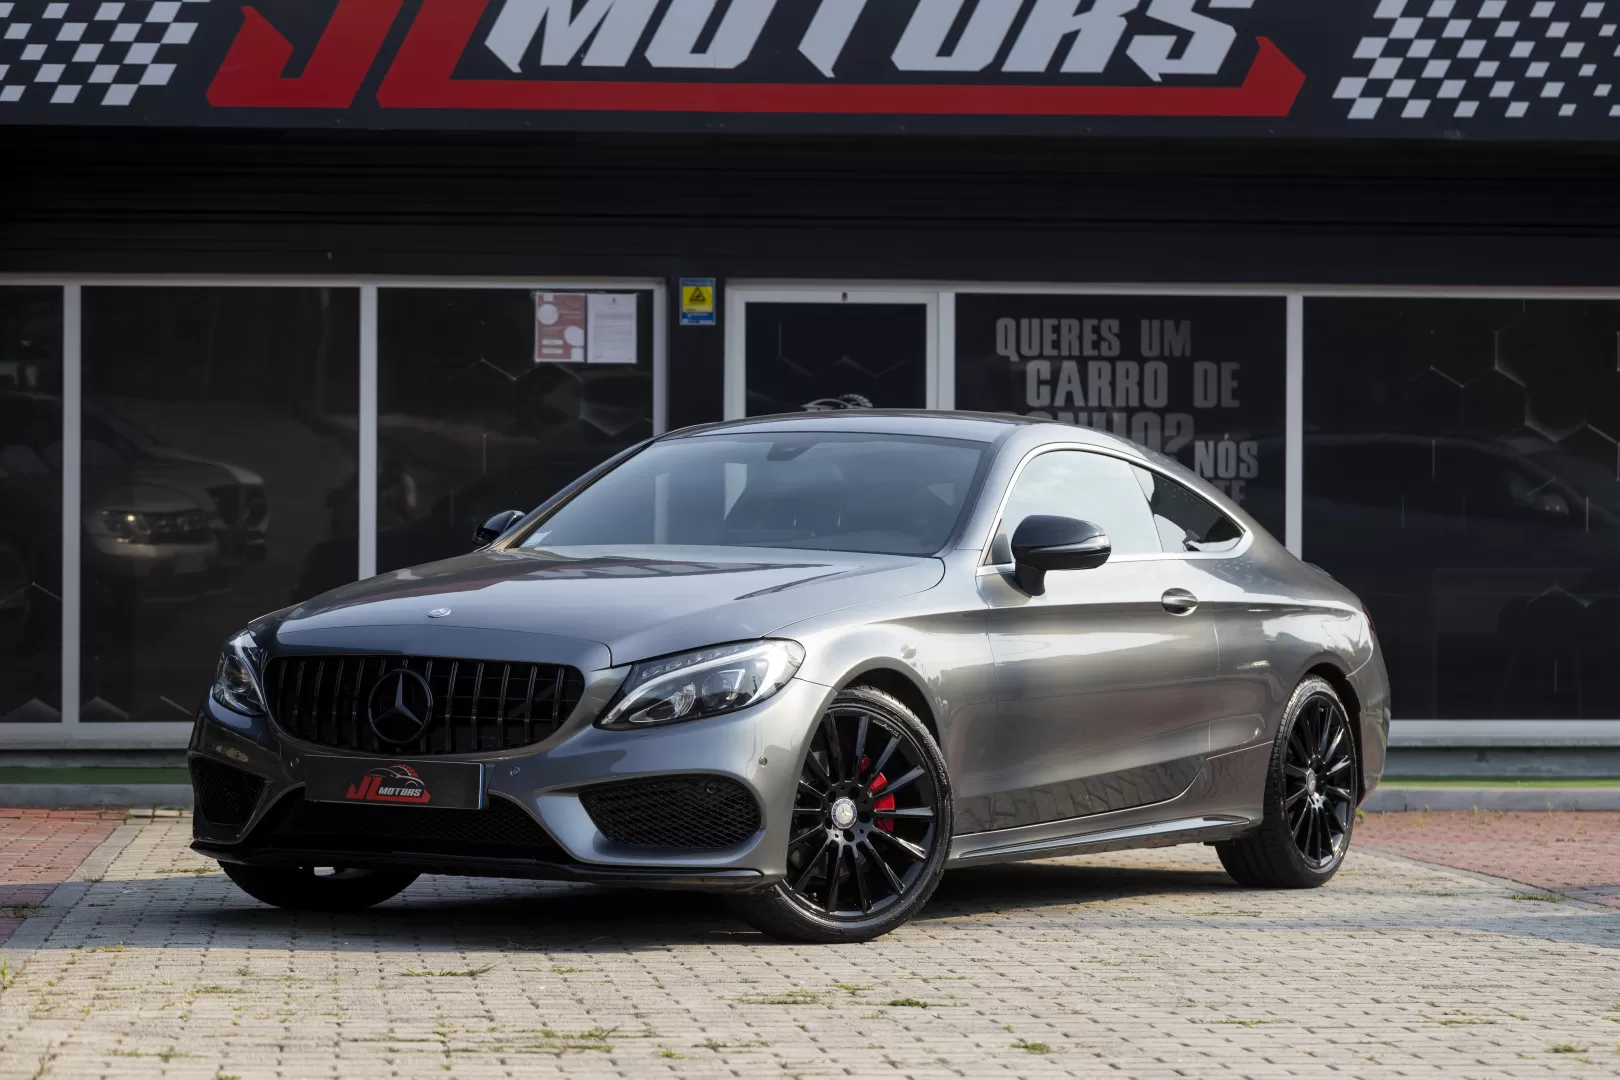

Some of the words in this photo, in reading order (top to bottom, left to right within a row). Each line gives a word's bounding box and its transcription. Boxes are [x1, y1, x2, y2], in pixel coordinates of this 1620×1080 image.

[995, 317, 1121, 362] QUERES
[1140, 319, 1192, 357] UM
[1025, 360, 1169, 407] CARRO
[1193, 361, 1241, 408] DE
[1195, 433, 1259, 478] NÓS
[345, 775, 383, 800] JL
[378, 787, 422, 797] MOTORS
